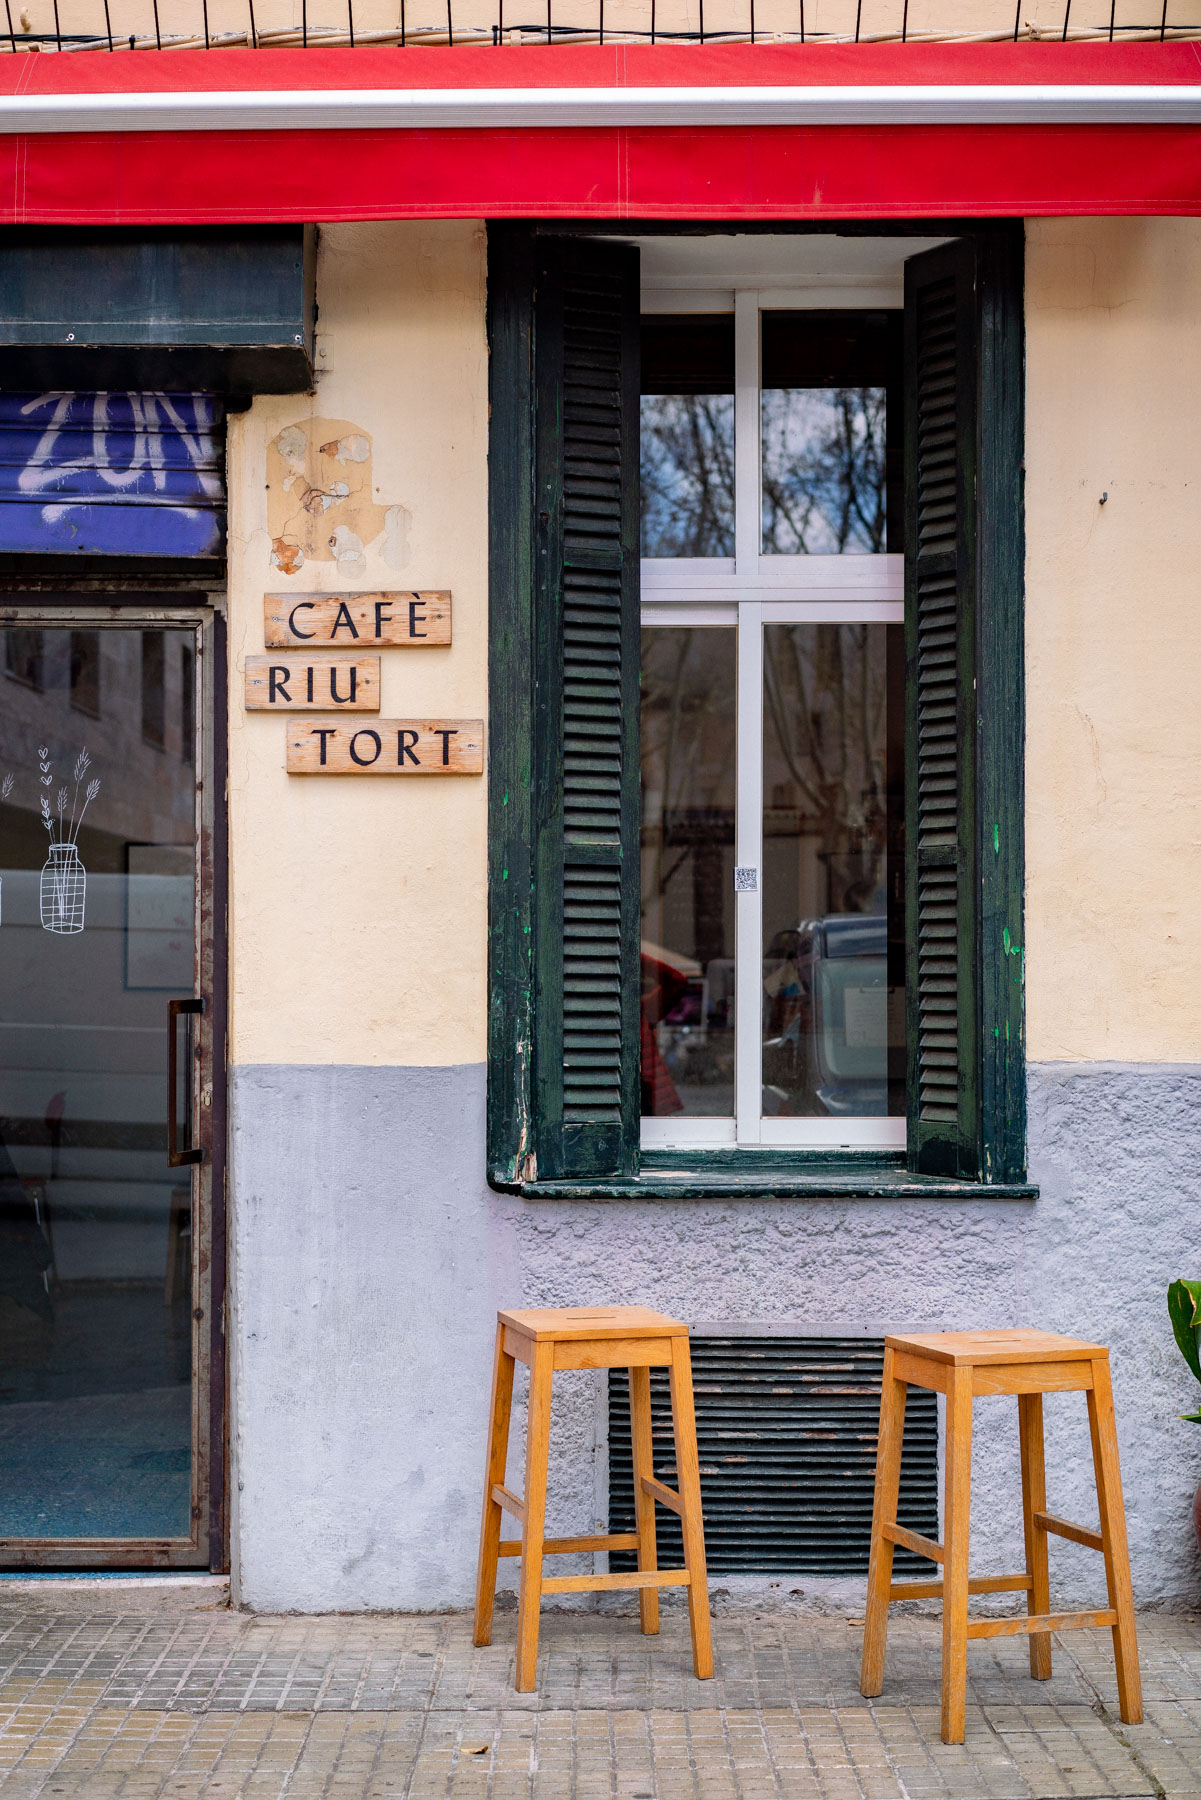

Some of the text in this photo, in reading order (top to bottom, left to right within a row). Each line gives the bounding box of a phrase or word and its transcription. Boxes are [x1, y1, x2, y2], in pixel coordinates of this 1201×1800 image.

[287, 591, 429, 640] CAFÈ
[268, 665, 358, 704] RIU
[310, 728, 460, 767] TORT
